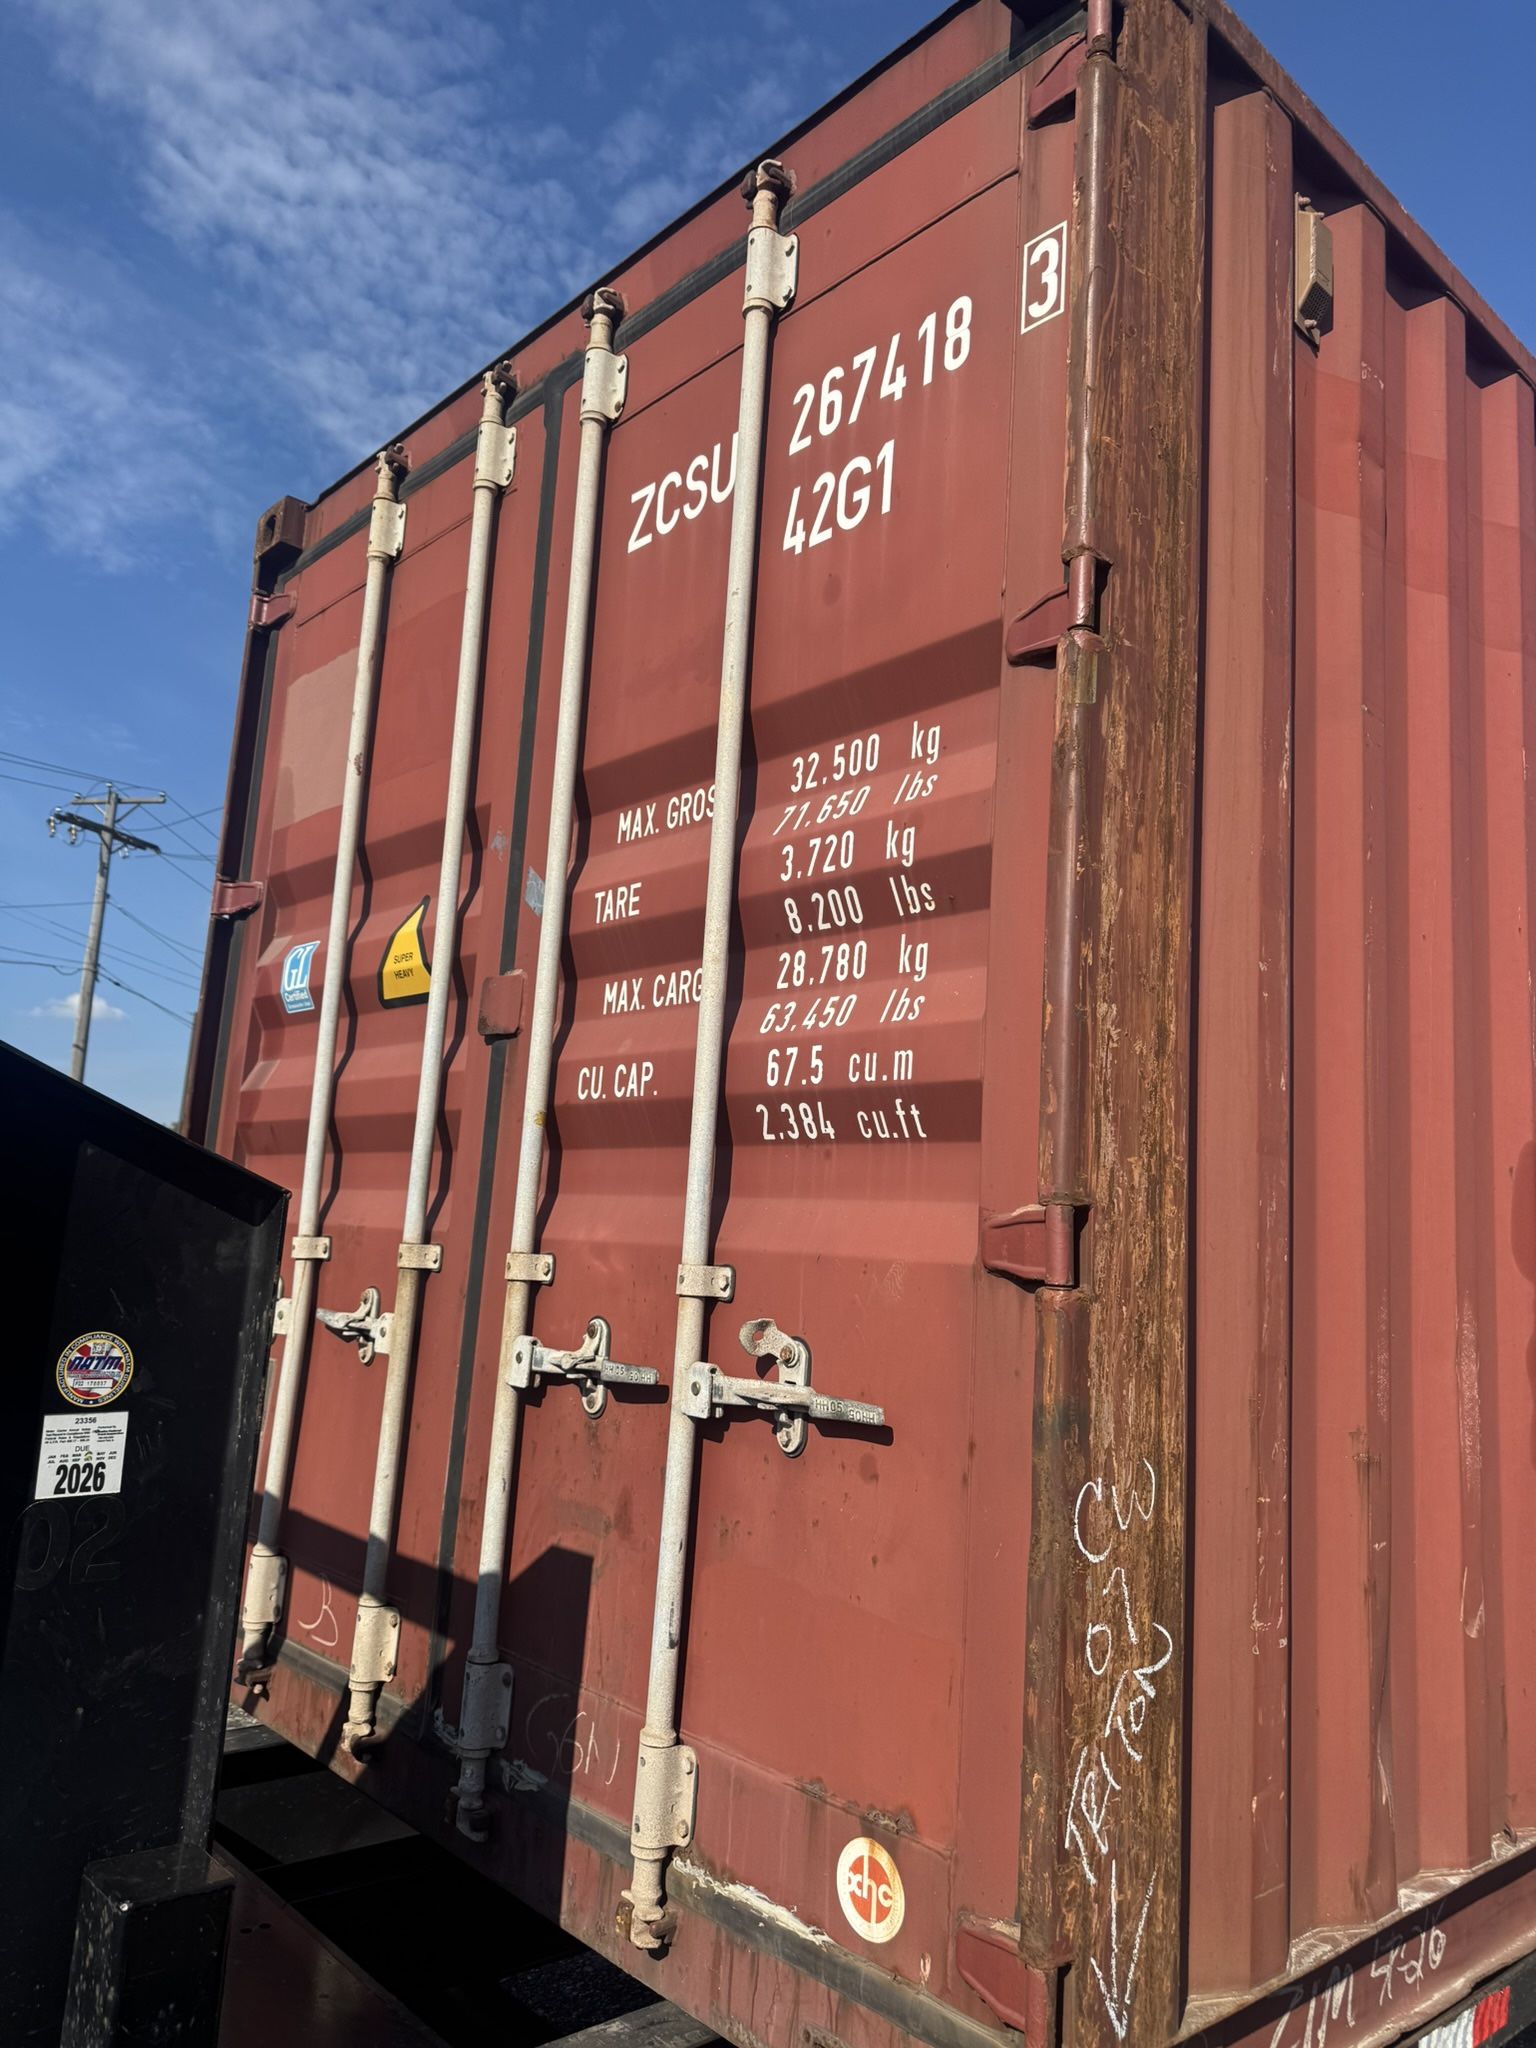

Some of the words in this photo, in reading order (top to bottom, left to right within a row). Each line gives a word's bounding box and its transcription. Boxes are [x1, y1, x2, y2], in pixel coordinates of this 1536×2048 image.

[627, 431, 739, 554] ZCSU
[789, 295, 973, 456] 267418
[1028, 237, 1060, 318] 3
[782, 439, 895, 555] 42G1
[617, 802, 660, 844] MAX.
[666, 784, 716, 829] GROS
[790, 733, 880, 793] 32.500
[911, 720, 941, 765] kg
[772, 785, 871, 836] 71.650
[893, 770, 939, 805] lbs
[594, 882, 642, 924] TARE
[780, 830, 855, 882] 3.720
[886, 820, 916, 867] kg
[784, 885, 864, 934] 8.200
[889, 874, 935, 916] lbs
[284, 944, 314, 991] GL
[393, 952, 414, 964] SUPER
[393, 968, 414, 980] HEAVY
[602, 977, 646, 1015] MAX.
[652, 967, 703, 1008] CARG
[776, 940, 867, 990] 28.780
[898, 933, 929, 982] kg
[759, 993, 858, 1034] 63.450
[879, 987, 926, 1023] lbs
[577, 1066, 606, 1100] CU.
[614, 1061, 658, 1098] CAP.
[766, 1044, 824, 1087] 67.5
[848, 1049, 913, 1083] cu.m
[755, 1101, 835, 1140] 2.384
[857, 1098, 927, 1139] cu.ft
[71, 1334, 113, 1349] COMPLIANCE
[53, 1461, 107, 1496] 2026
